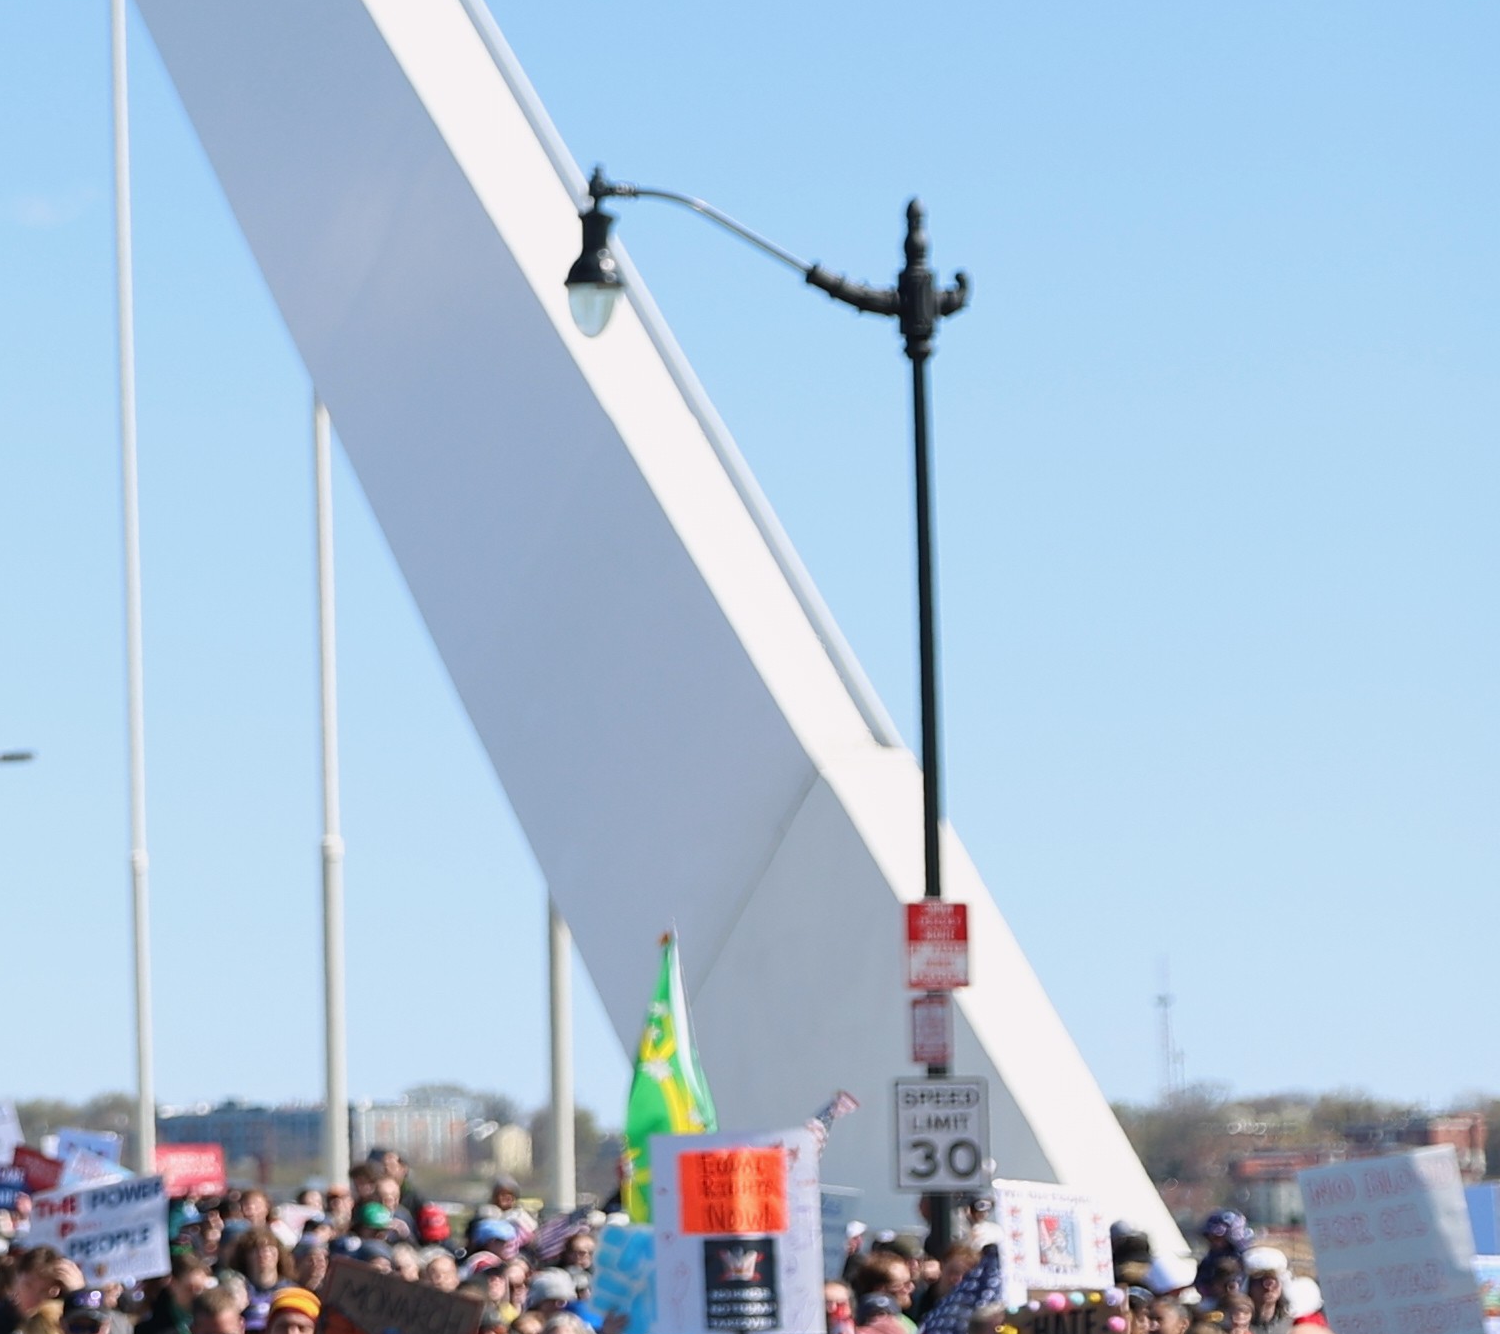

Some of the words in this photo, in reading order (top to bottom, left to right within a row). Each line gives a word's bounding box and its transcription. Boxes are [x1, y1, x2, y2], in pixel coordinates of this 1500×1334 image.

[905, 1089, 979, 1108] SPEED
[913, 1113, 970, 1133] LIMIT
[909, 1140, 980, 1181] 30
[1310, 1174, 1356, 1208] NO
[36, 1199, 77, 1219] THE
[1318, 1214, 1376, 1252] FOR
[1379, 1203, 1428, 1240] OIL
[71, 1229, 150, 1259] PEOPLE
[1327, 1273, 1375, 1306] NO
[1377, 1263, 1448, 1295] WAR
